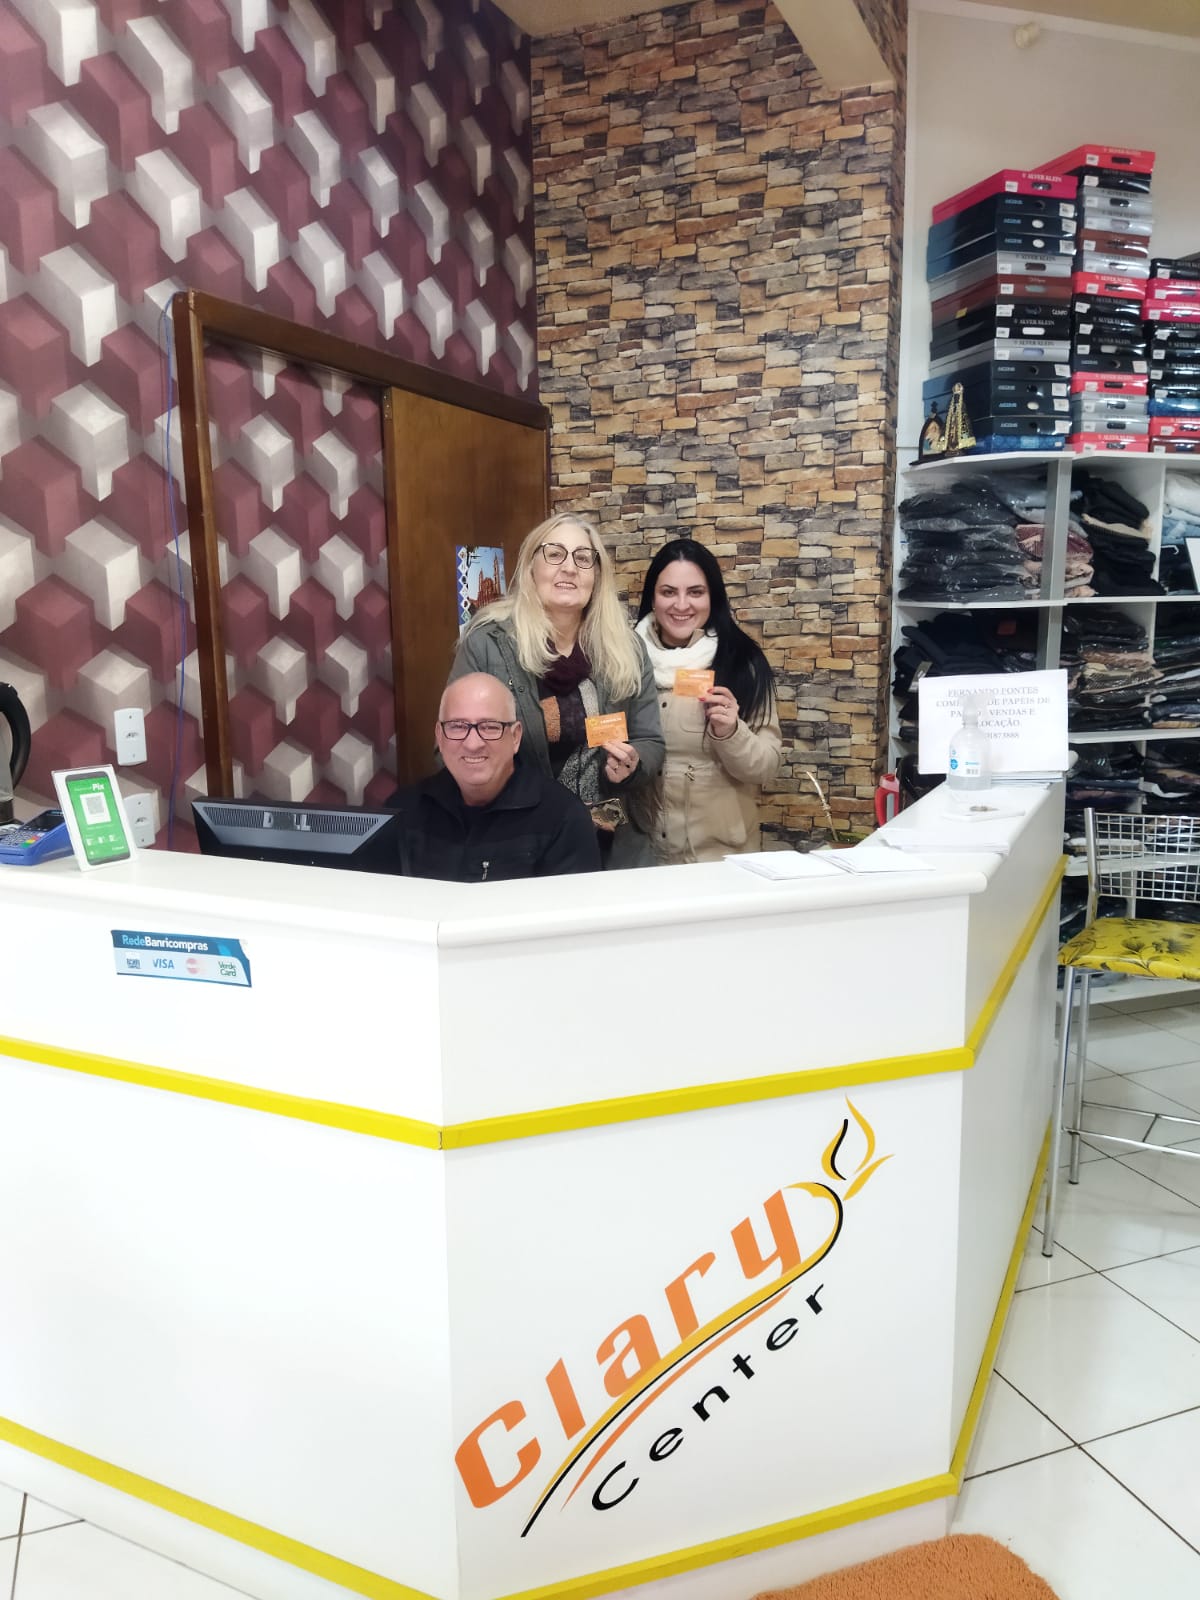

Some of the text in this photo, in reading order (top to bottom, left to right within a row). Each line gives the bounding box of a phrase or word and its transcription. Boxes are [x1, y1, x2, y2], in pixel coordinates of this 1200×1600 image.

[989, 708, 1027, 717] VENDAS
[263, 811, 311, 831] DLL
[153, 958, 175, 970] VISA
[220, 968, 237, 977] Card
[454, 1188, 802, 1510] Clary
[591, 1282, 824, 1512] Center
